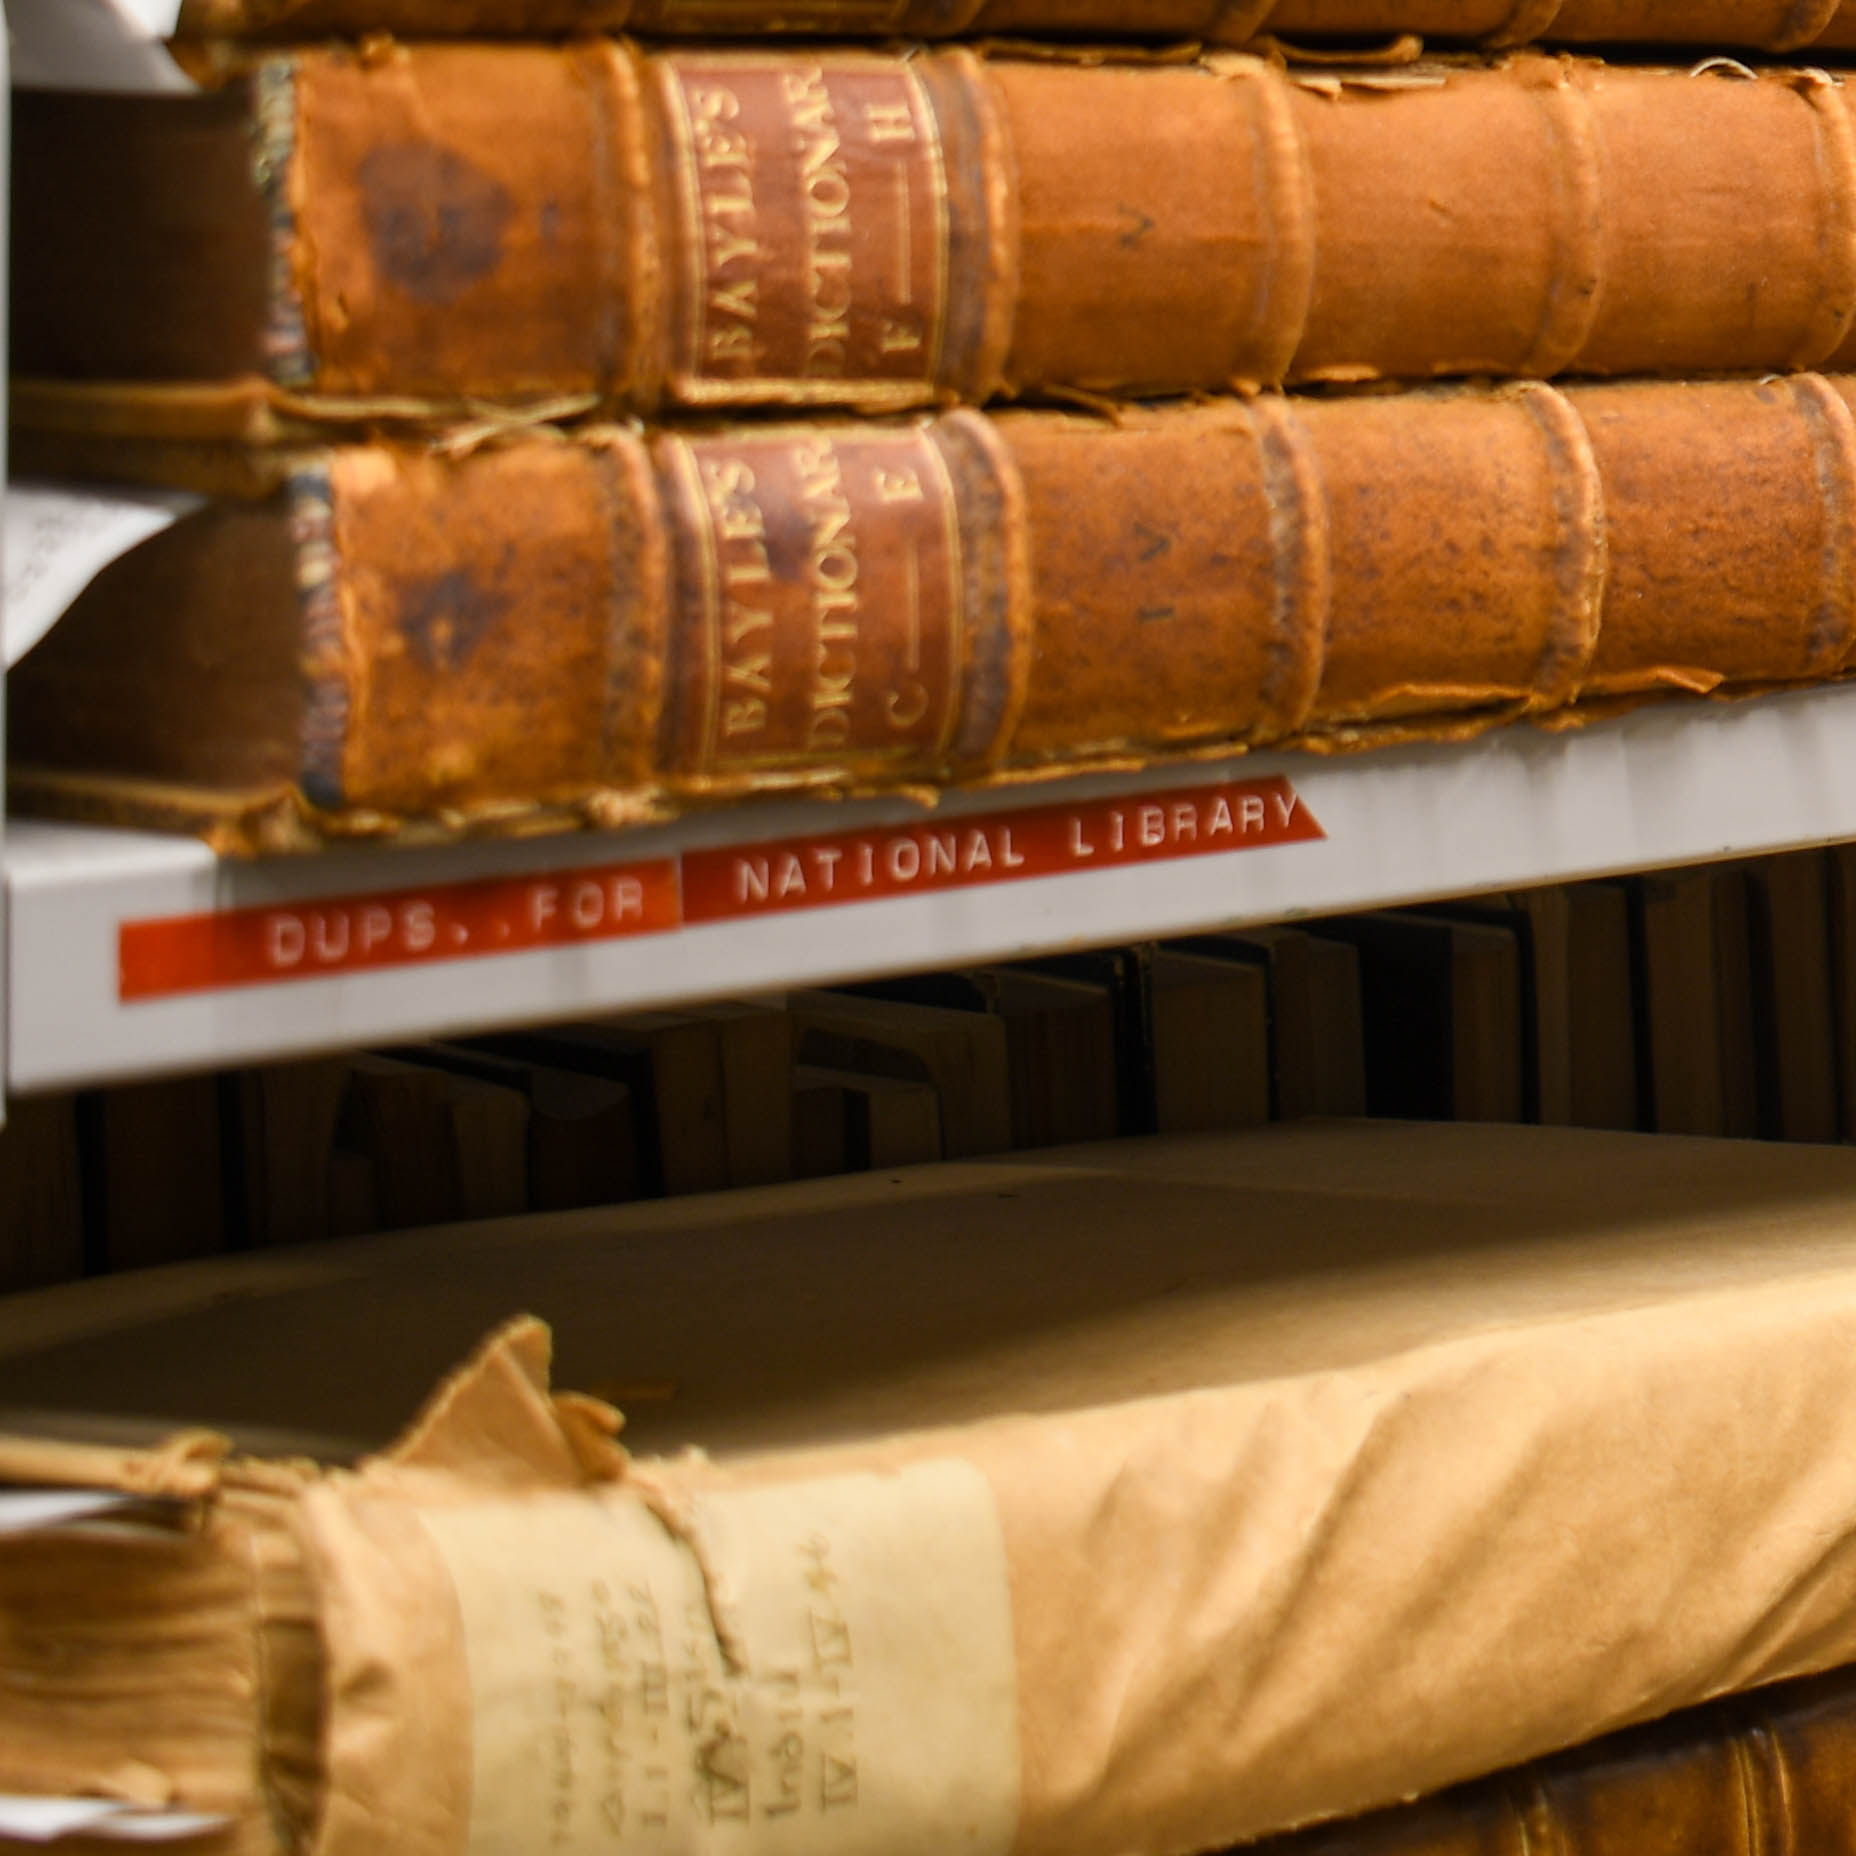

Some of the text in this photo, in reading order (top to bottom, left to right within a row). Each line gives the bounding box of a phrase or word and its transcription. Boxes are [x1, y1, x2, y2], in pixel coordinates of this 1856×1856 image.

[528, 875, 645, 930] FOR
[734, 826, 1026, 903] NATIONAL
[1070, 789, 1300, 859] LIBRARY
